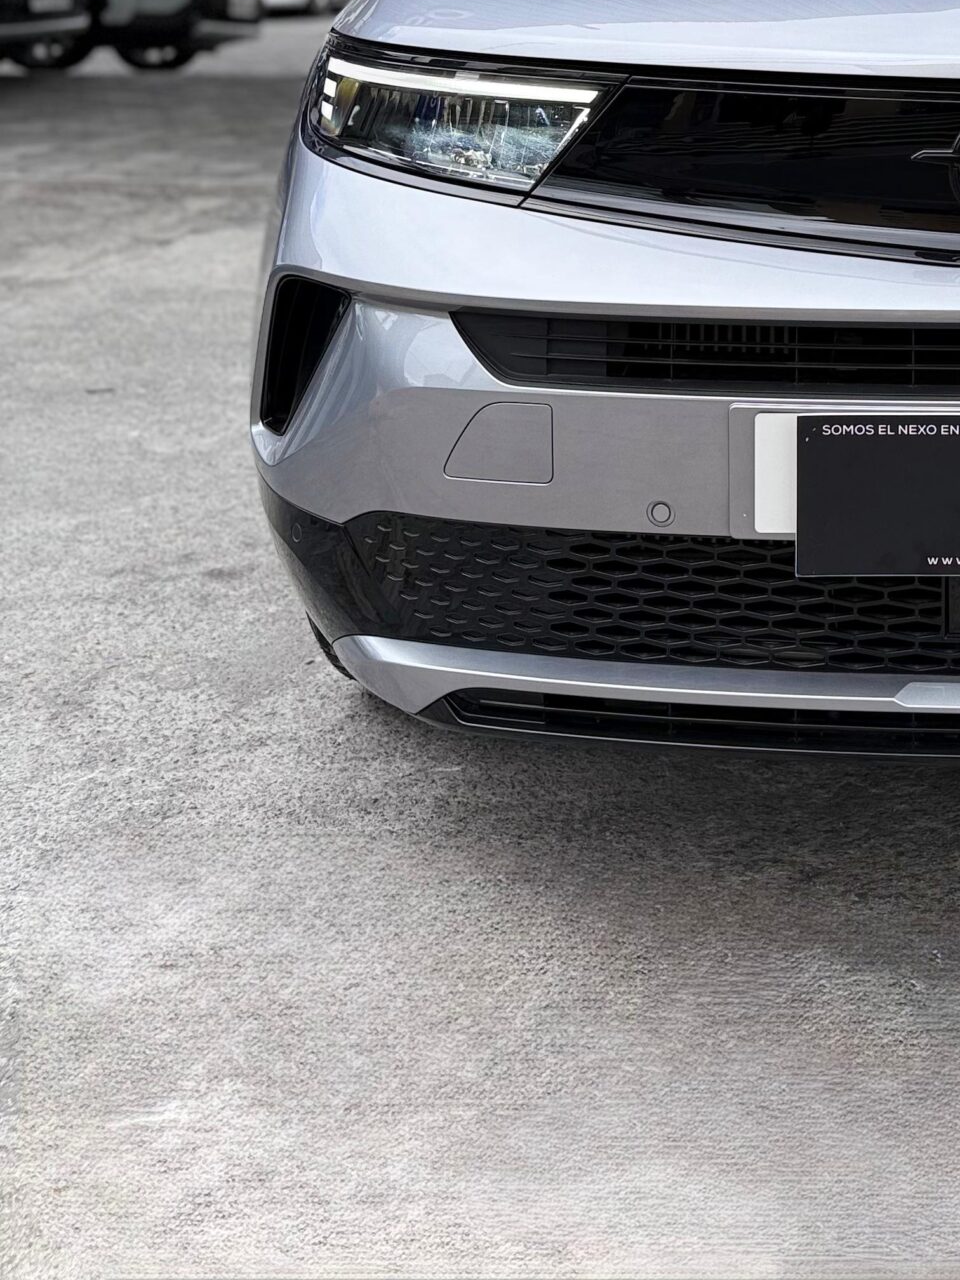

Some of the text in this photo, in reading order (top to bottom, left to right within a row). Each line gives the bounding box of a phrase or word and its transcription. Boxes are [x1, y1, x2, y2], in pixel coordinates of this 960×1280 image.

[822, 424, 875, 436] SOMOS
[878, 424, 895, 436] EL
[898, 424, 937, 436] NEXO
